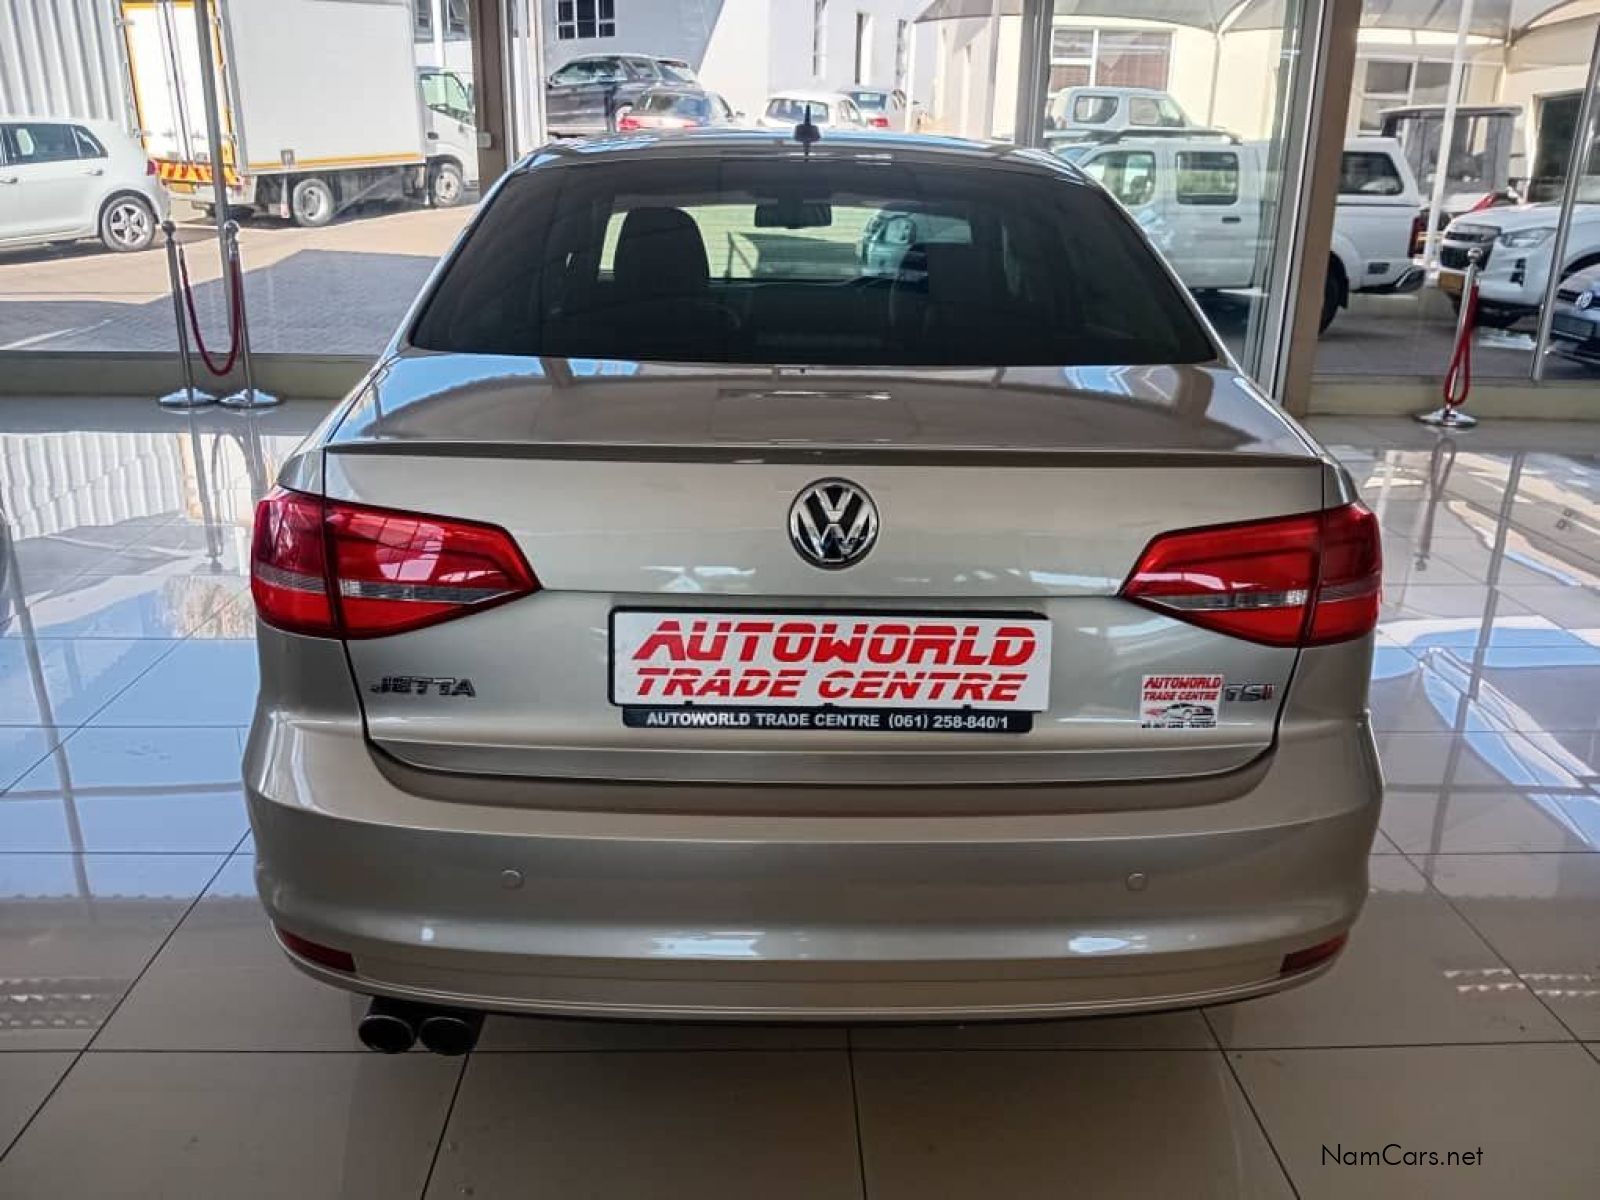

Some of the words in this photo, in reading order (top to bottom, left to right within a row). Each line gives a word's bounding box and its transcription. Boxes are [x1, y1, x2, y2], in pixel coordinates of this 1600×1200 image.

[632, 620, 1036, 667] AUTOWORLD
[368, 675, 476, 697] JETTA
[635, 667, 808, 698] TRADE
[816, 672, 1028, 702] CENTRE
[1143, 676, 1222, 690] AUTOWORLD
[1143, 691, 1177, 701] TRADE
[1178, 691, 1219, 701] CENTRE
[646, 712, 751, 728] AUTOWORLD
[754, 713, 811, 728] TRADE
[814, 713, 881, 728] CENTRE
[888, 713, 929, 730] (061)
[932, 714, 1009, 730] 258-840/1
